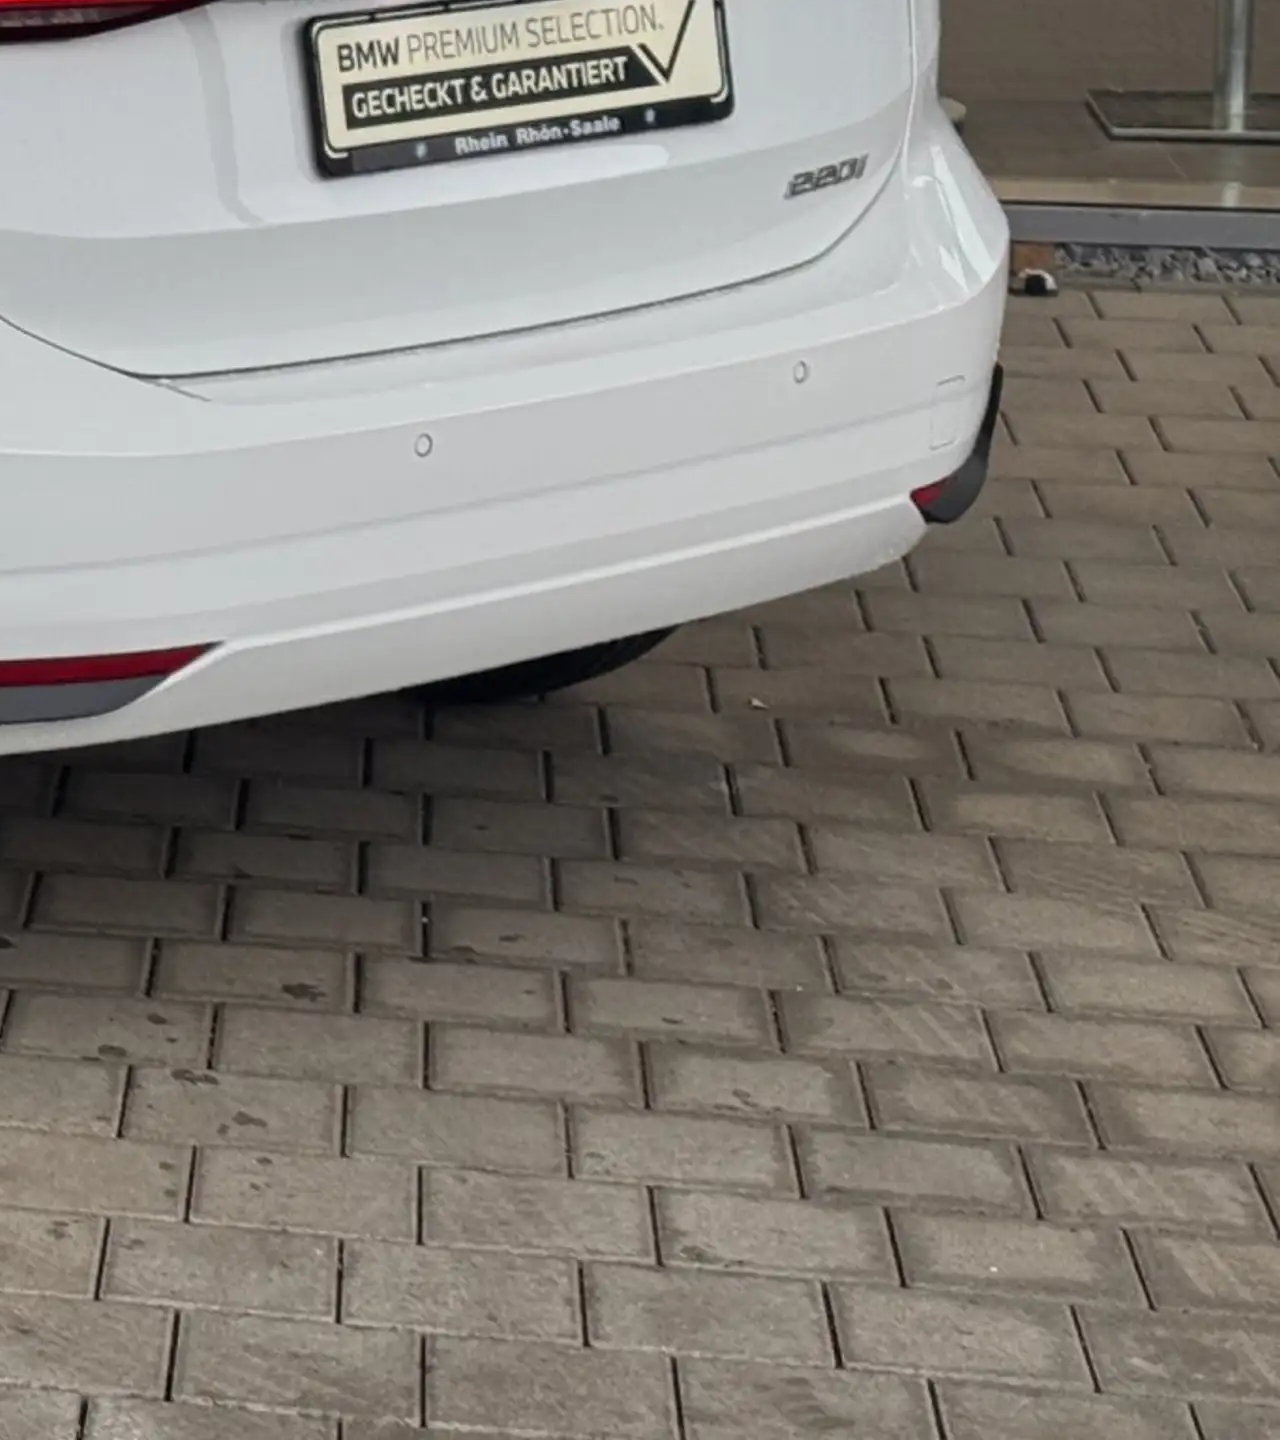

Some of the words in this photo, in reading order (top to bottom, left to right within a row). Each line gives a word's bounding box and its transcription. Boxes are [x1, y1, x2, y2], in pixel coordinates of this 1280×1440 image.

[336, 37, 401, 73] BMW
[406, 21, 521, 65] PREMIUM
[527, 2, 665, 49] SELECTION.
[350, 78, 465, 119] GECHECKT
[469, 75, 489, 103] &
[490, 56, 629, 100] GARANTIERT
[453, 132, 509, 156] Rhein
